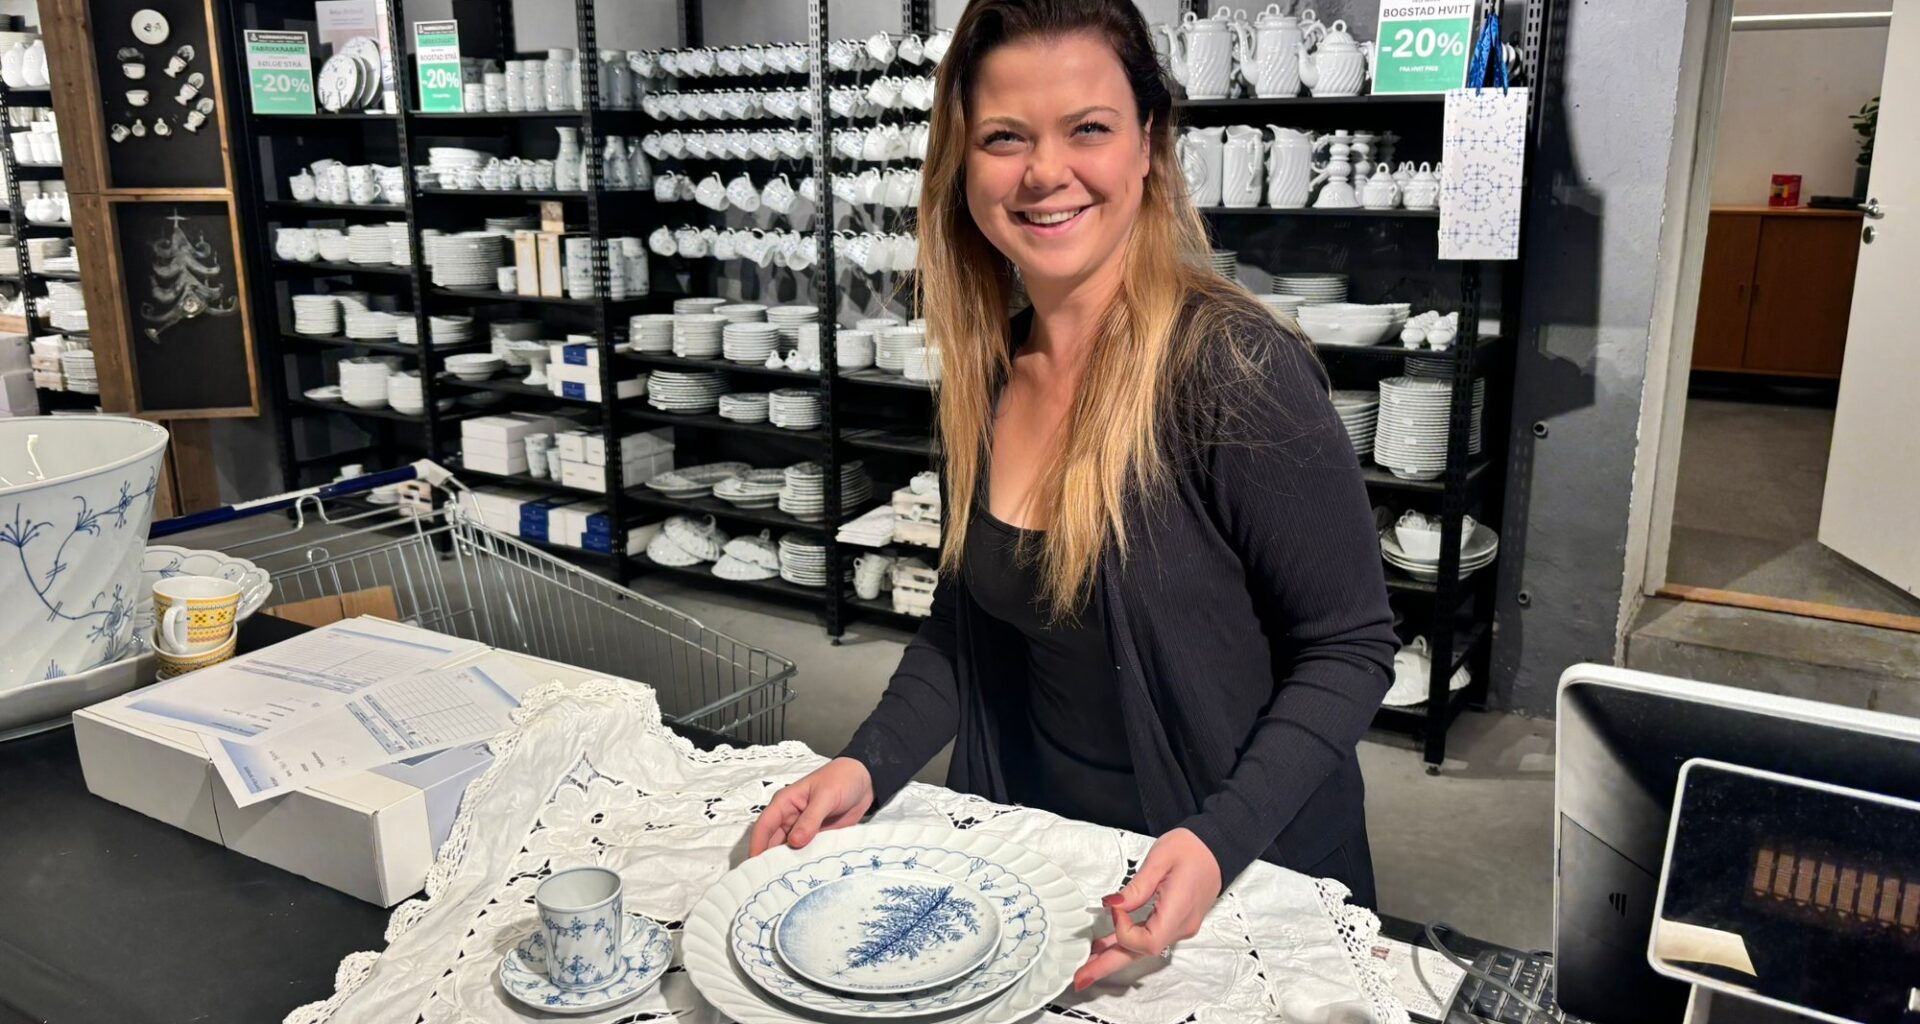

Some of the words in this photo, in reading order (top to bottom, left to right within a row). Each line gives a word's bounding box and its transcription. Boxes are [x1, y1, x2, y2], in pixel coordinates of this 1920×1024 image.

[1383, 7, 1435, 18] BOGSTAD
[1438, 4, 1471, 15] HVITT
[1381, 27, 1464, 58] -20%
[255, 73, 310, 93] -20%
[422, 68, 460, 89] -20%
